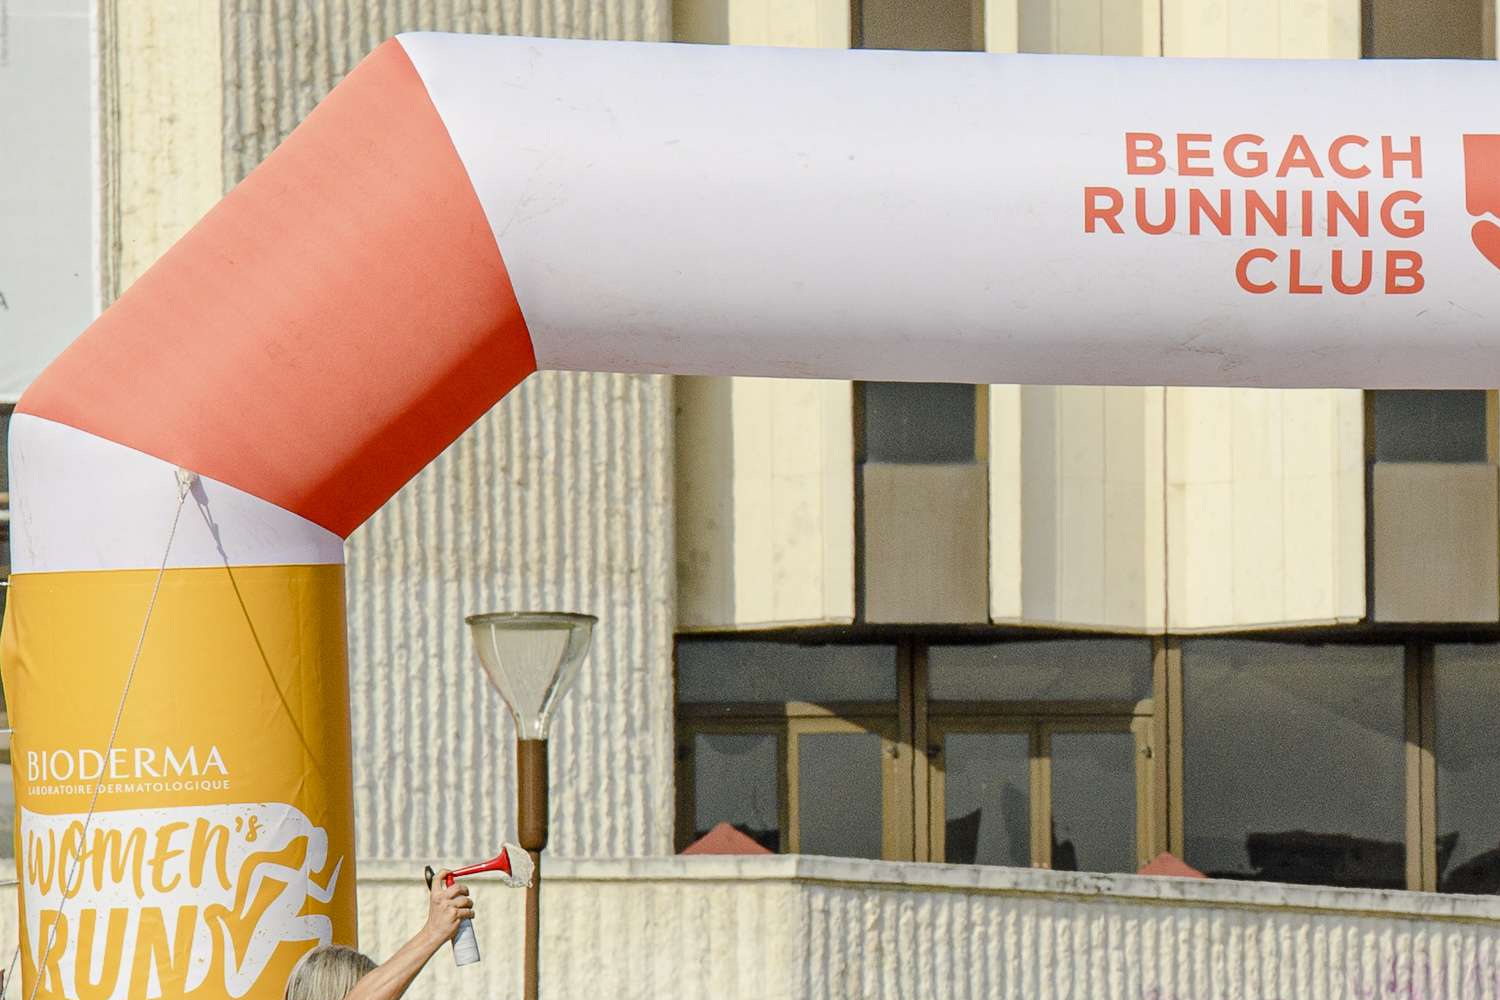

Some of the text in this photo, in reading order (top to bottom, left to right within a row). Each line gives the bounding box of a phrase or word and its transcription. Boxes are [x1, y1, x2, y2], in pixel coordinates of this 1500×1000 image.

[1125, 132, 1424, 179] BEGACH
[1084, 187, 1426, 236] RUNNING
[1235, 248, 1425, 295] CLUB
[28, 745, 229, 781] BIODERMA
[28, 779, 230, 796] LABORATOIRE DERMATOLOGIQUE
